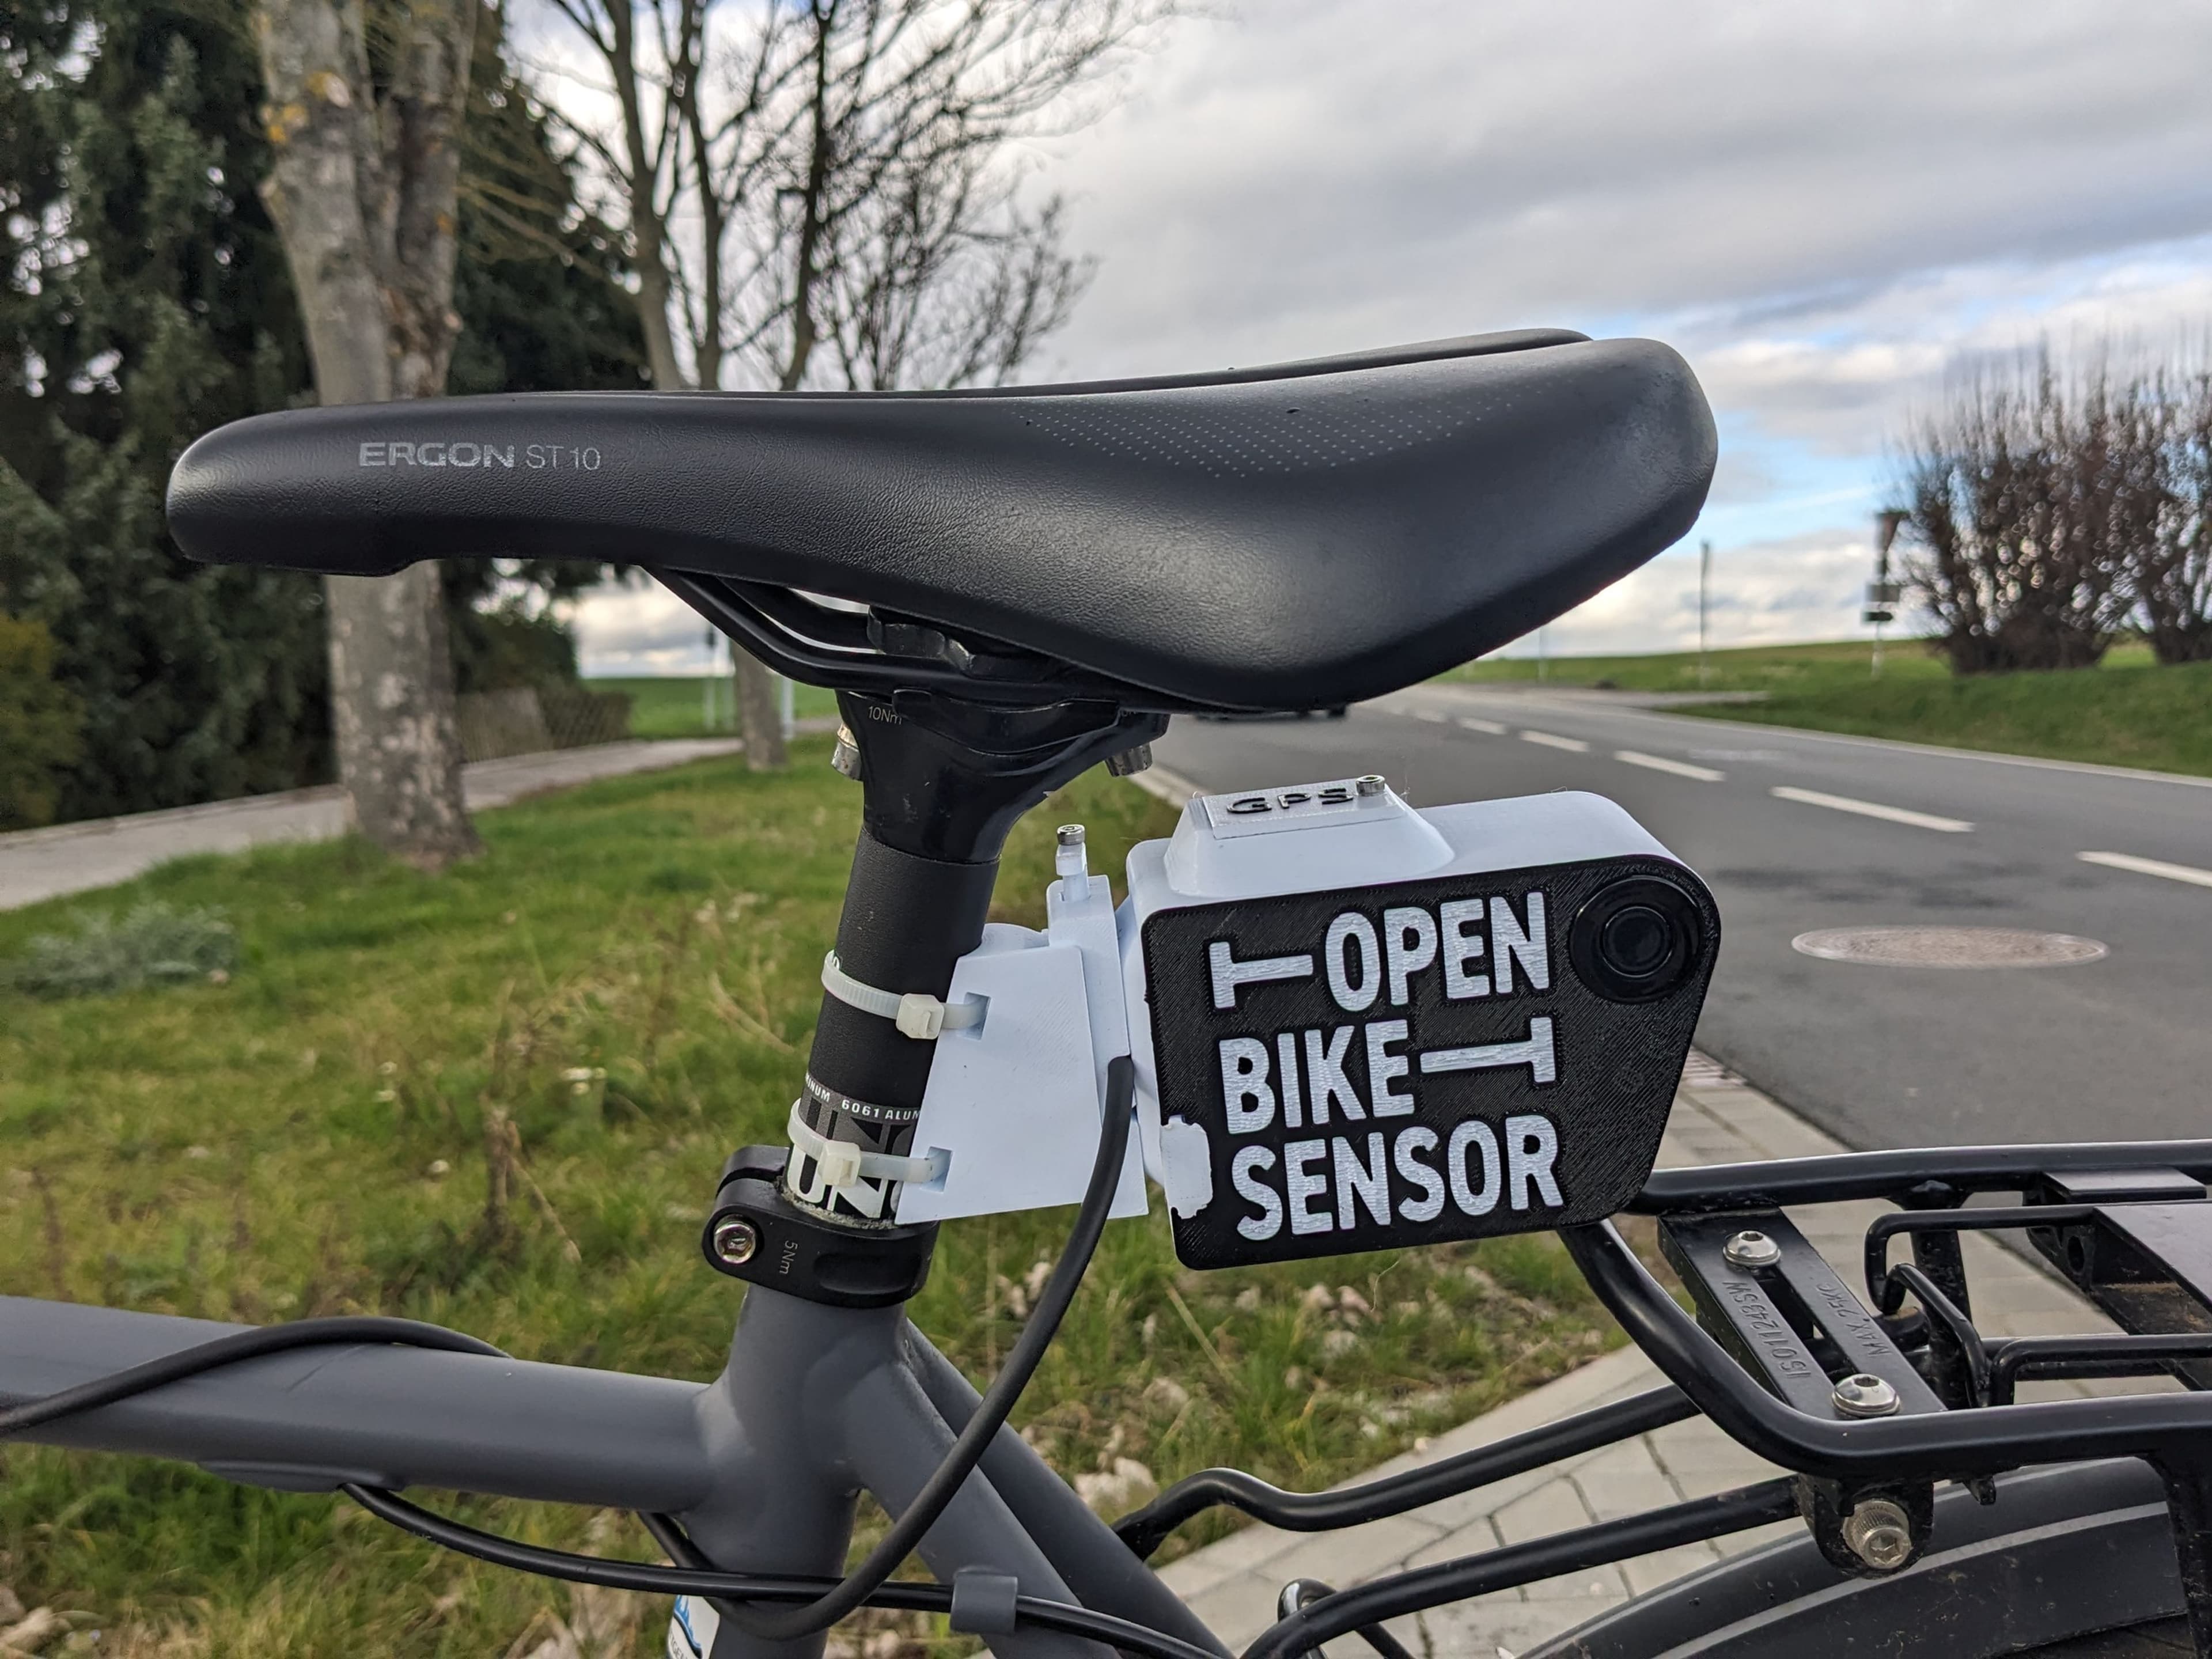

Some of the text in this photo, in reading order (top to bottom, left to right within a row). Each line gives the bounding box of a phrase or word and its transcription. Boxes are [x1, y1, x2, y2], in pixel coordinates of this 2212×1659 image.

[359, 442, 515, 468] ERGON
[868, 706, 902, 725] 10Nm
[1226, 787, 1354, 814] GPS
[1324, 891, 1550, 1012] OPEN
[1218, 1018, 1415, 1135] BIKE
[842, 1099, 880, 1118] 6061
[1231, 1113, 1564, 1241] SENSOR
